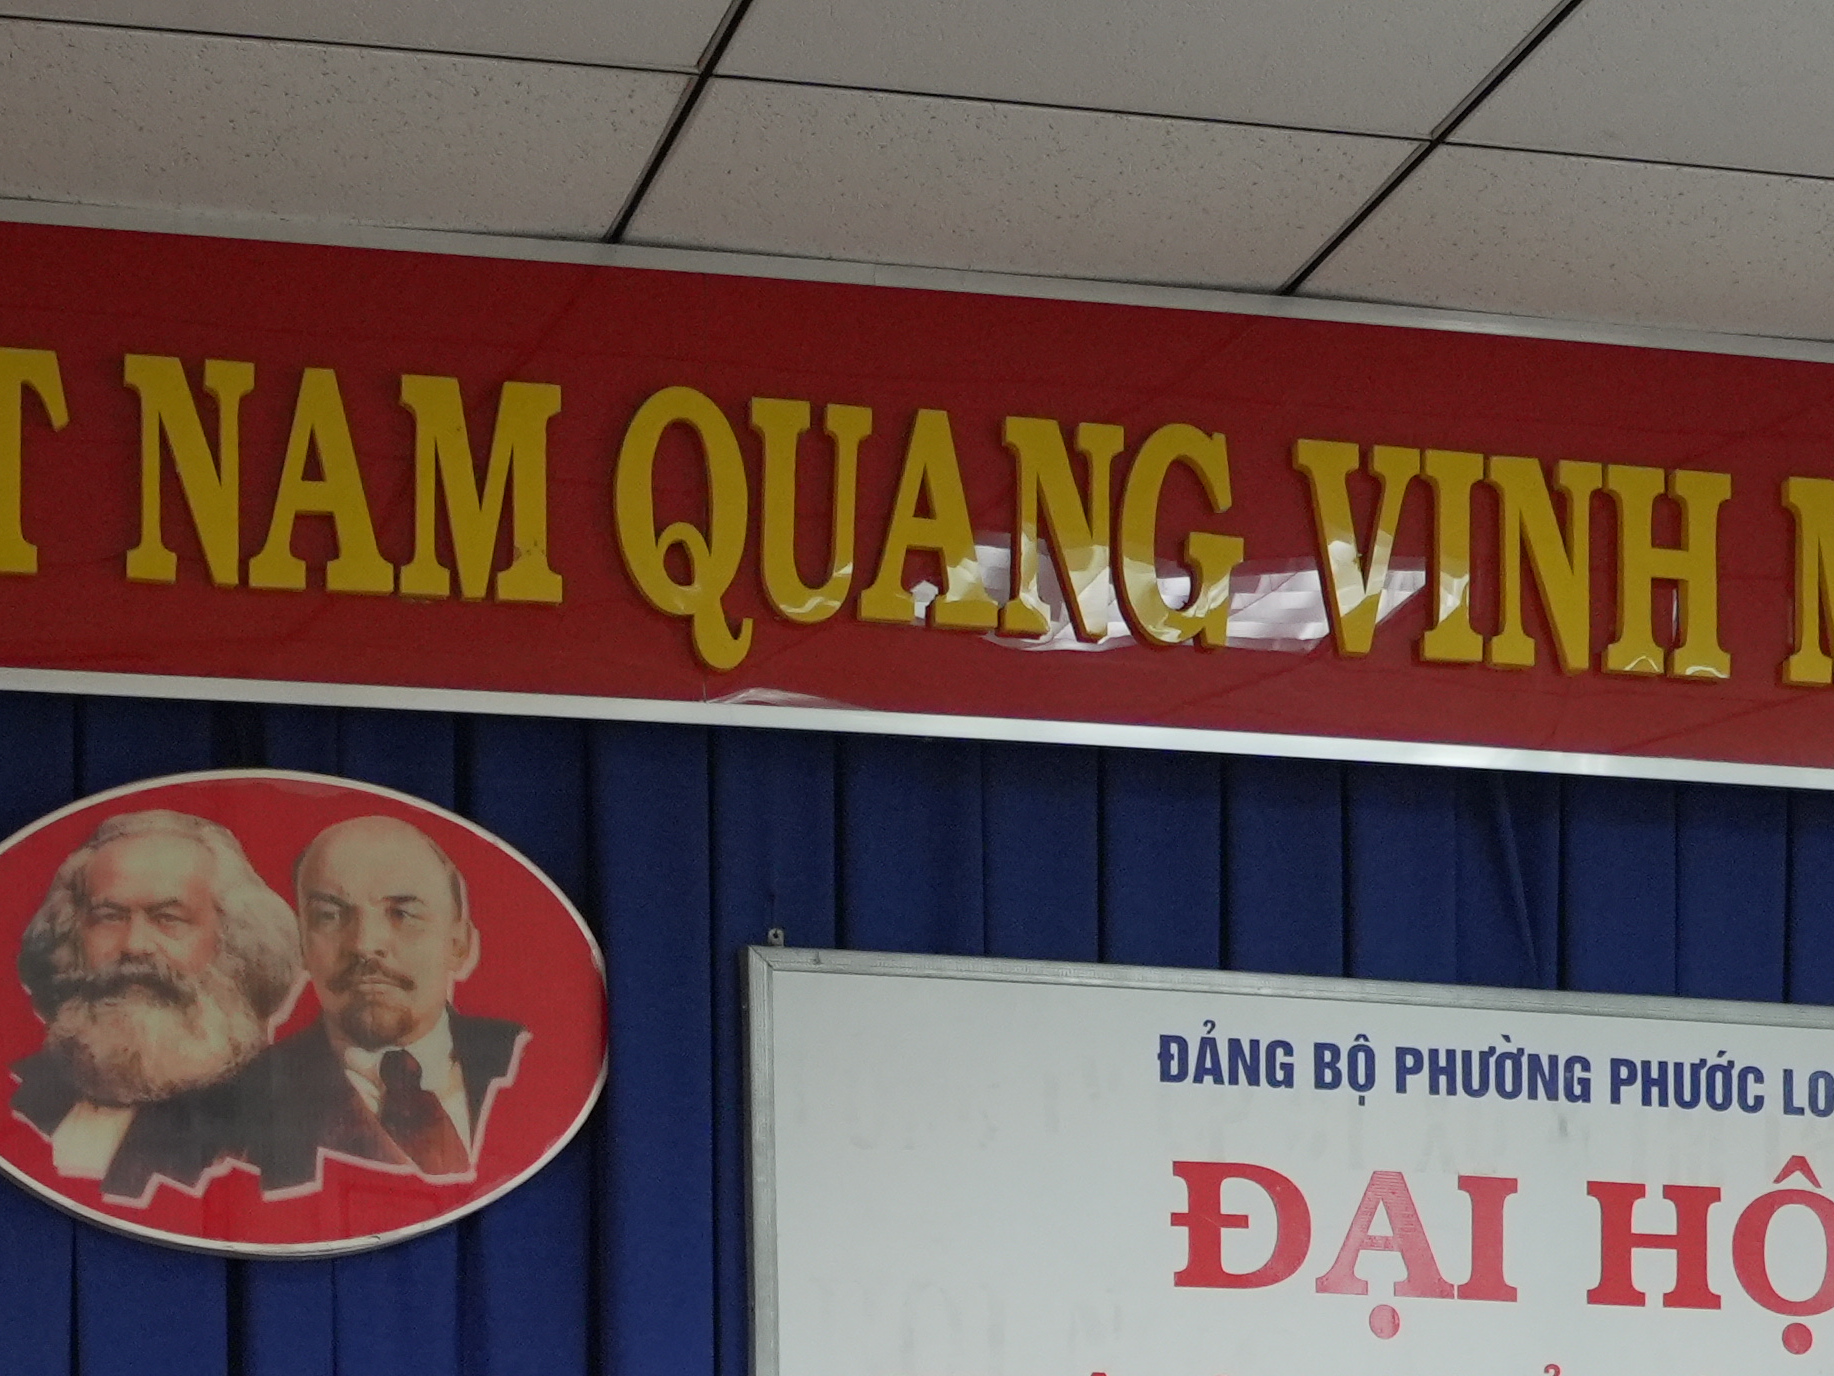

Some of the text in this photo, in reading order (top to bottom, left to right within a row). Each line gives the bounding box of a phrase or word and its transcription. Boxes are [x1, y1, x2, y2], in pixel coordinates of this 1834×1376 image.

[123, 353, 565, 604] NAM
[613, 384, 1245, 673] QUANG
[1292, 438, 1733, 680] VINH
[1157, 1020, 1294, 1088] ĐẢNG
[1314, 1034, 1375, 1106] BỘ
[1395, 1034, 1591, 1103] PHƯỜNG
[1610, 1050, 1764, 1113] PHƯỚC
[1170, 1161, 1518, 1338] ĐẠI
